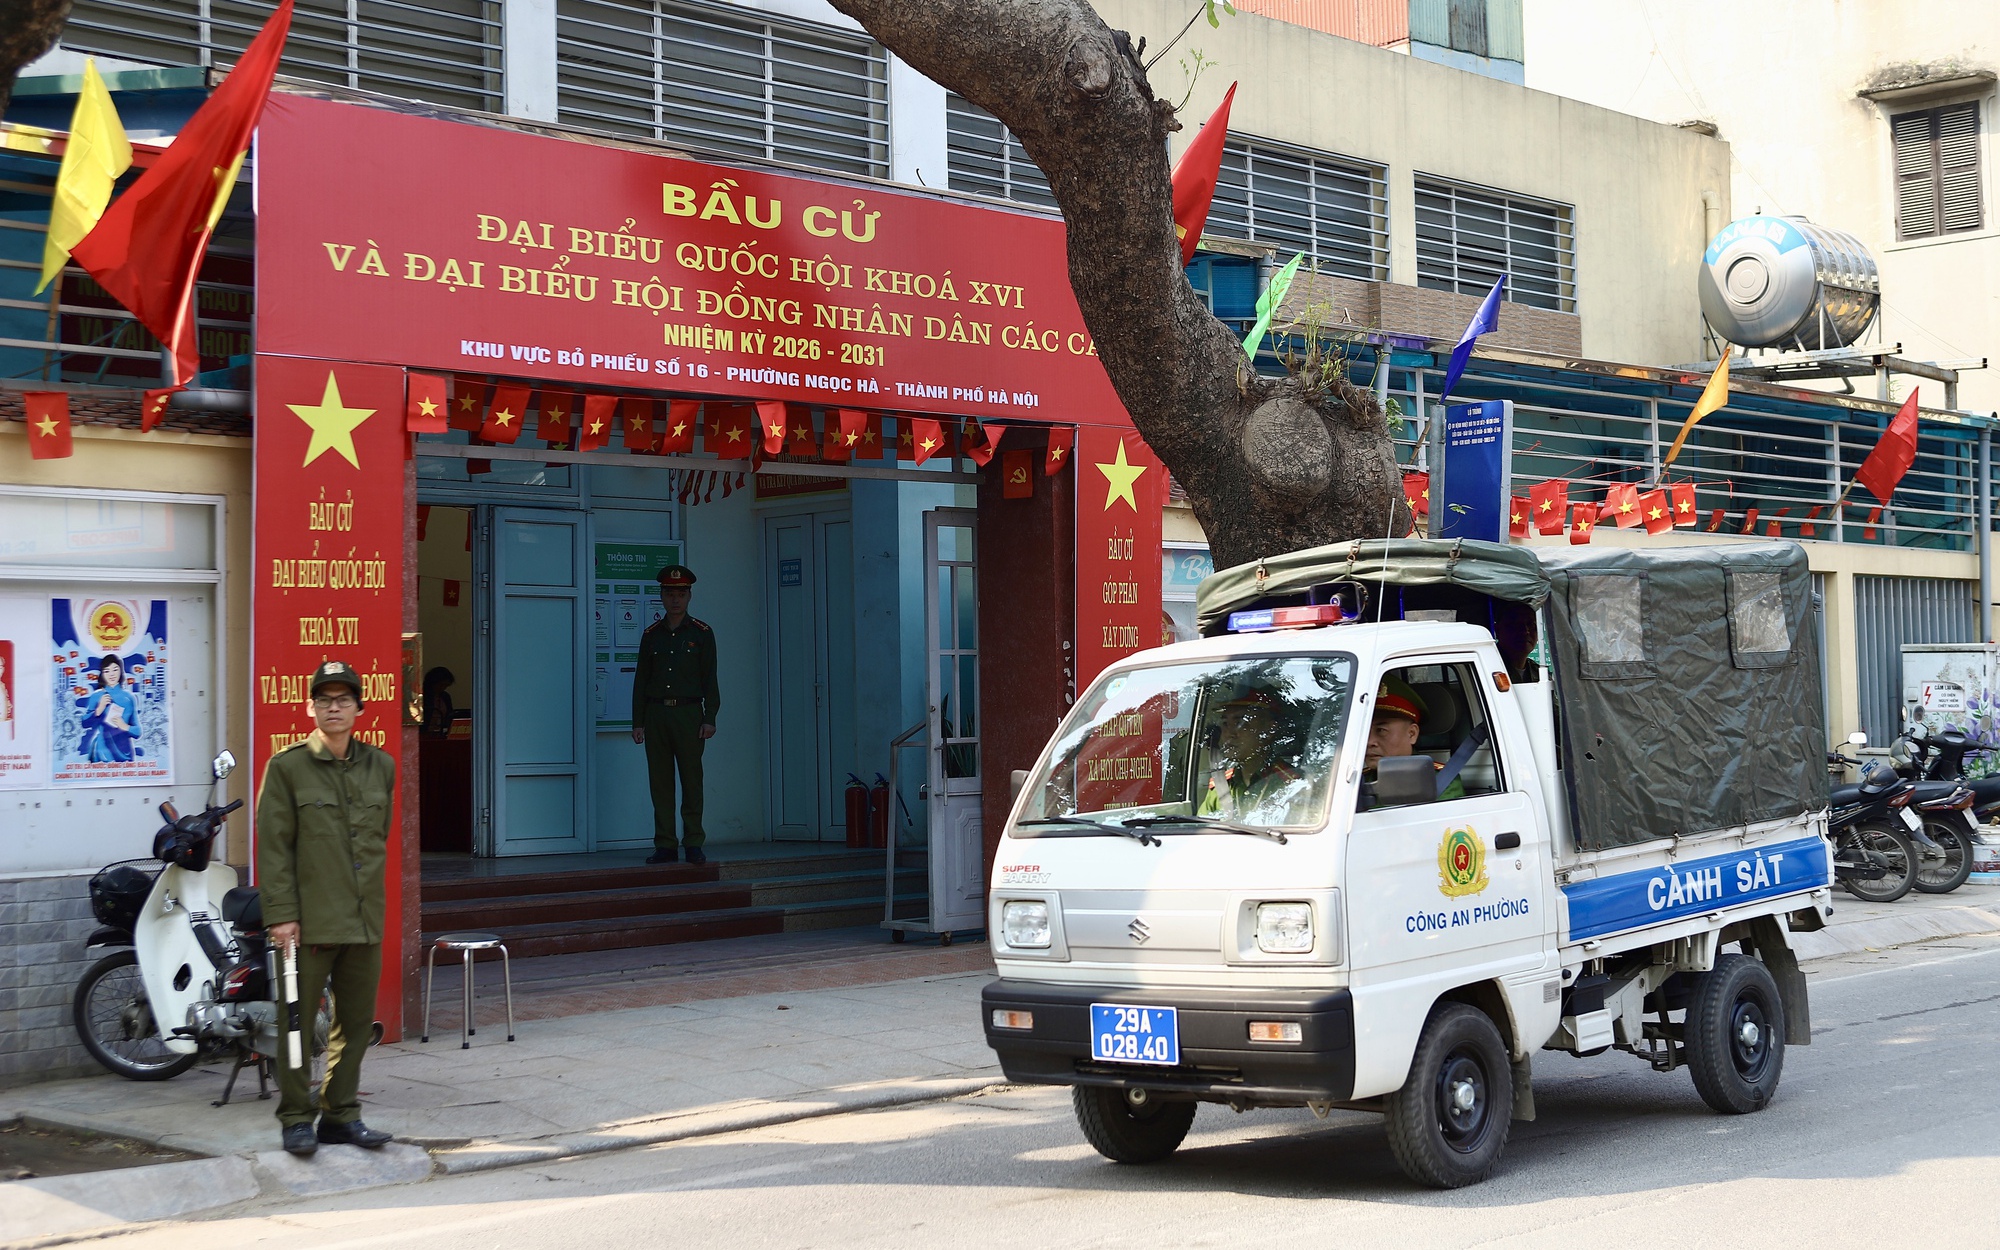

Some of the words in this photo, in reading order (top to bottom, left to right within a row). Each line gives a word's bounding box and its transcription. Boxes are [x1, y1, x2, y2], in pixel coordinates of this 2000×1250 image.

[663, 179, 781, 228] BẦU
[803, 200, 881, 242] CỬ
[478, 215, 554, 253] ĐẠI
[568, 218, 663, 263] BIỂU
[676, 241, 778, 278] QUỐC
[790, 254, 851, 292] HỘI
[865, 268, 959, 300] KHOÁ
[969, 282, 1024, 308] XVI
[323, 240, 389, 276] VÀ
[405, 253, 484, 292] ĐẠI
[500, 255, 598, 301] BIỂU
[613, 276, 683, 316] HỘI
[697, 281, 803, 327] ĐỒNG
[813, 303, 912, 336] NHÂN
[924, 313, 992, 345] DÂN
[1002, 321, 1058, 352] CÁC
[664, 323, 733, 356] NHIỆM
[741, 329, 766, 354] KỲ
[773, 336, 820, 360] 2026
[841, 343, 883, 366] 2031
[462, 340, 503, 358] KHU
[511, 346, 550, 364] VỰC
[558, 348, 584, 366] BỎ
[591, 354, 648, 372] PHIẾU
[655, 357, 679, 375] SỐ
[687, 364, 708, 377] 16
[727, 367, 799, 386] PHƯỜNG
[806, 375, 851, 392] NGỌC
[858, 378, 879, 393] HÀ
[896, 382, 947, 399] THÀNH
[953, 387, 983, 402] PHỐ
[989, 389, 1008, 404] HÀ
[1013, 392, 1038, 409] NỘI
[309, 485, 335, 531] BẦU
[337, 489, 354, 531] CỬ
[635, 554, 646, 562] TIN
[1108, 525, 1123, 560] BẦU
[1124, 528, 1135, 560] CỬ
[272, 559, 296, 596] ĐẠI
[298, 540, 327, 588] BIỂU
[329, 546, 362, 591] QUỐC
[364, 551, 386, 596] HỘI
[1103, 575, 1118, 605] GÓP
[1119, 570, 1139, 605] PHẦN
[300, 609, 333, 645] KHOÁ
[337, 617, 359, 645] XVI
[1103, 619, 1118, 648] XÂY
[1119, 622, 1139, 654] DỰNG
[261, 666, 279, 704] VÀ
[281, 675, 303, 711] ĐẠI
[361, 658, 395, 702] ĐỒNG
[1001, 873, 1051, 884] CARRY
[1003, 865, 1040, 873] SUPER
[1406, 910, 1447, 933] CÔNG
[1452, 909, 1470, 927] AN
[1474, 897, 1529, 923] PHƯỜNG
[1114, 1008, 1152, 1034] 29A
[1101, 1033, 1169, 1061] 028.40
